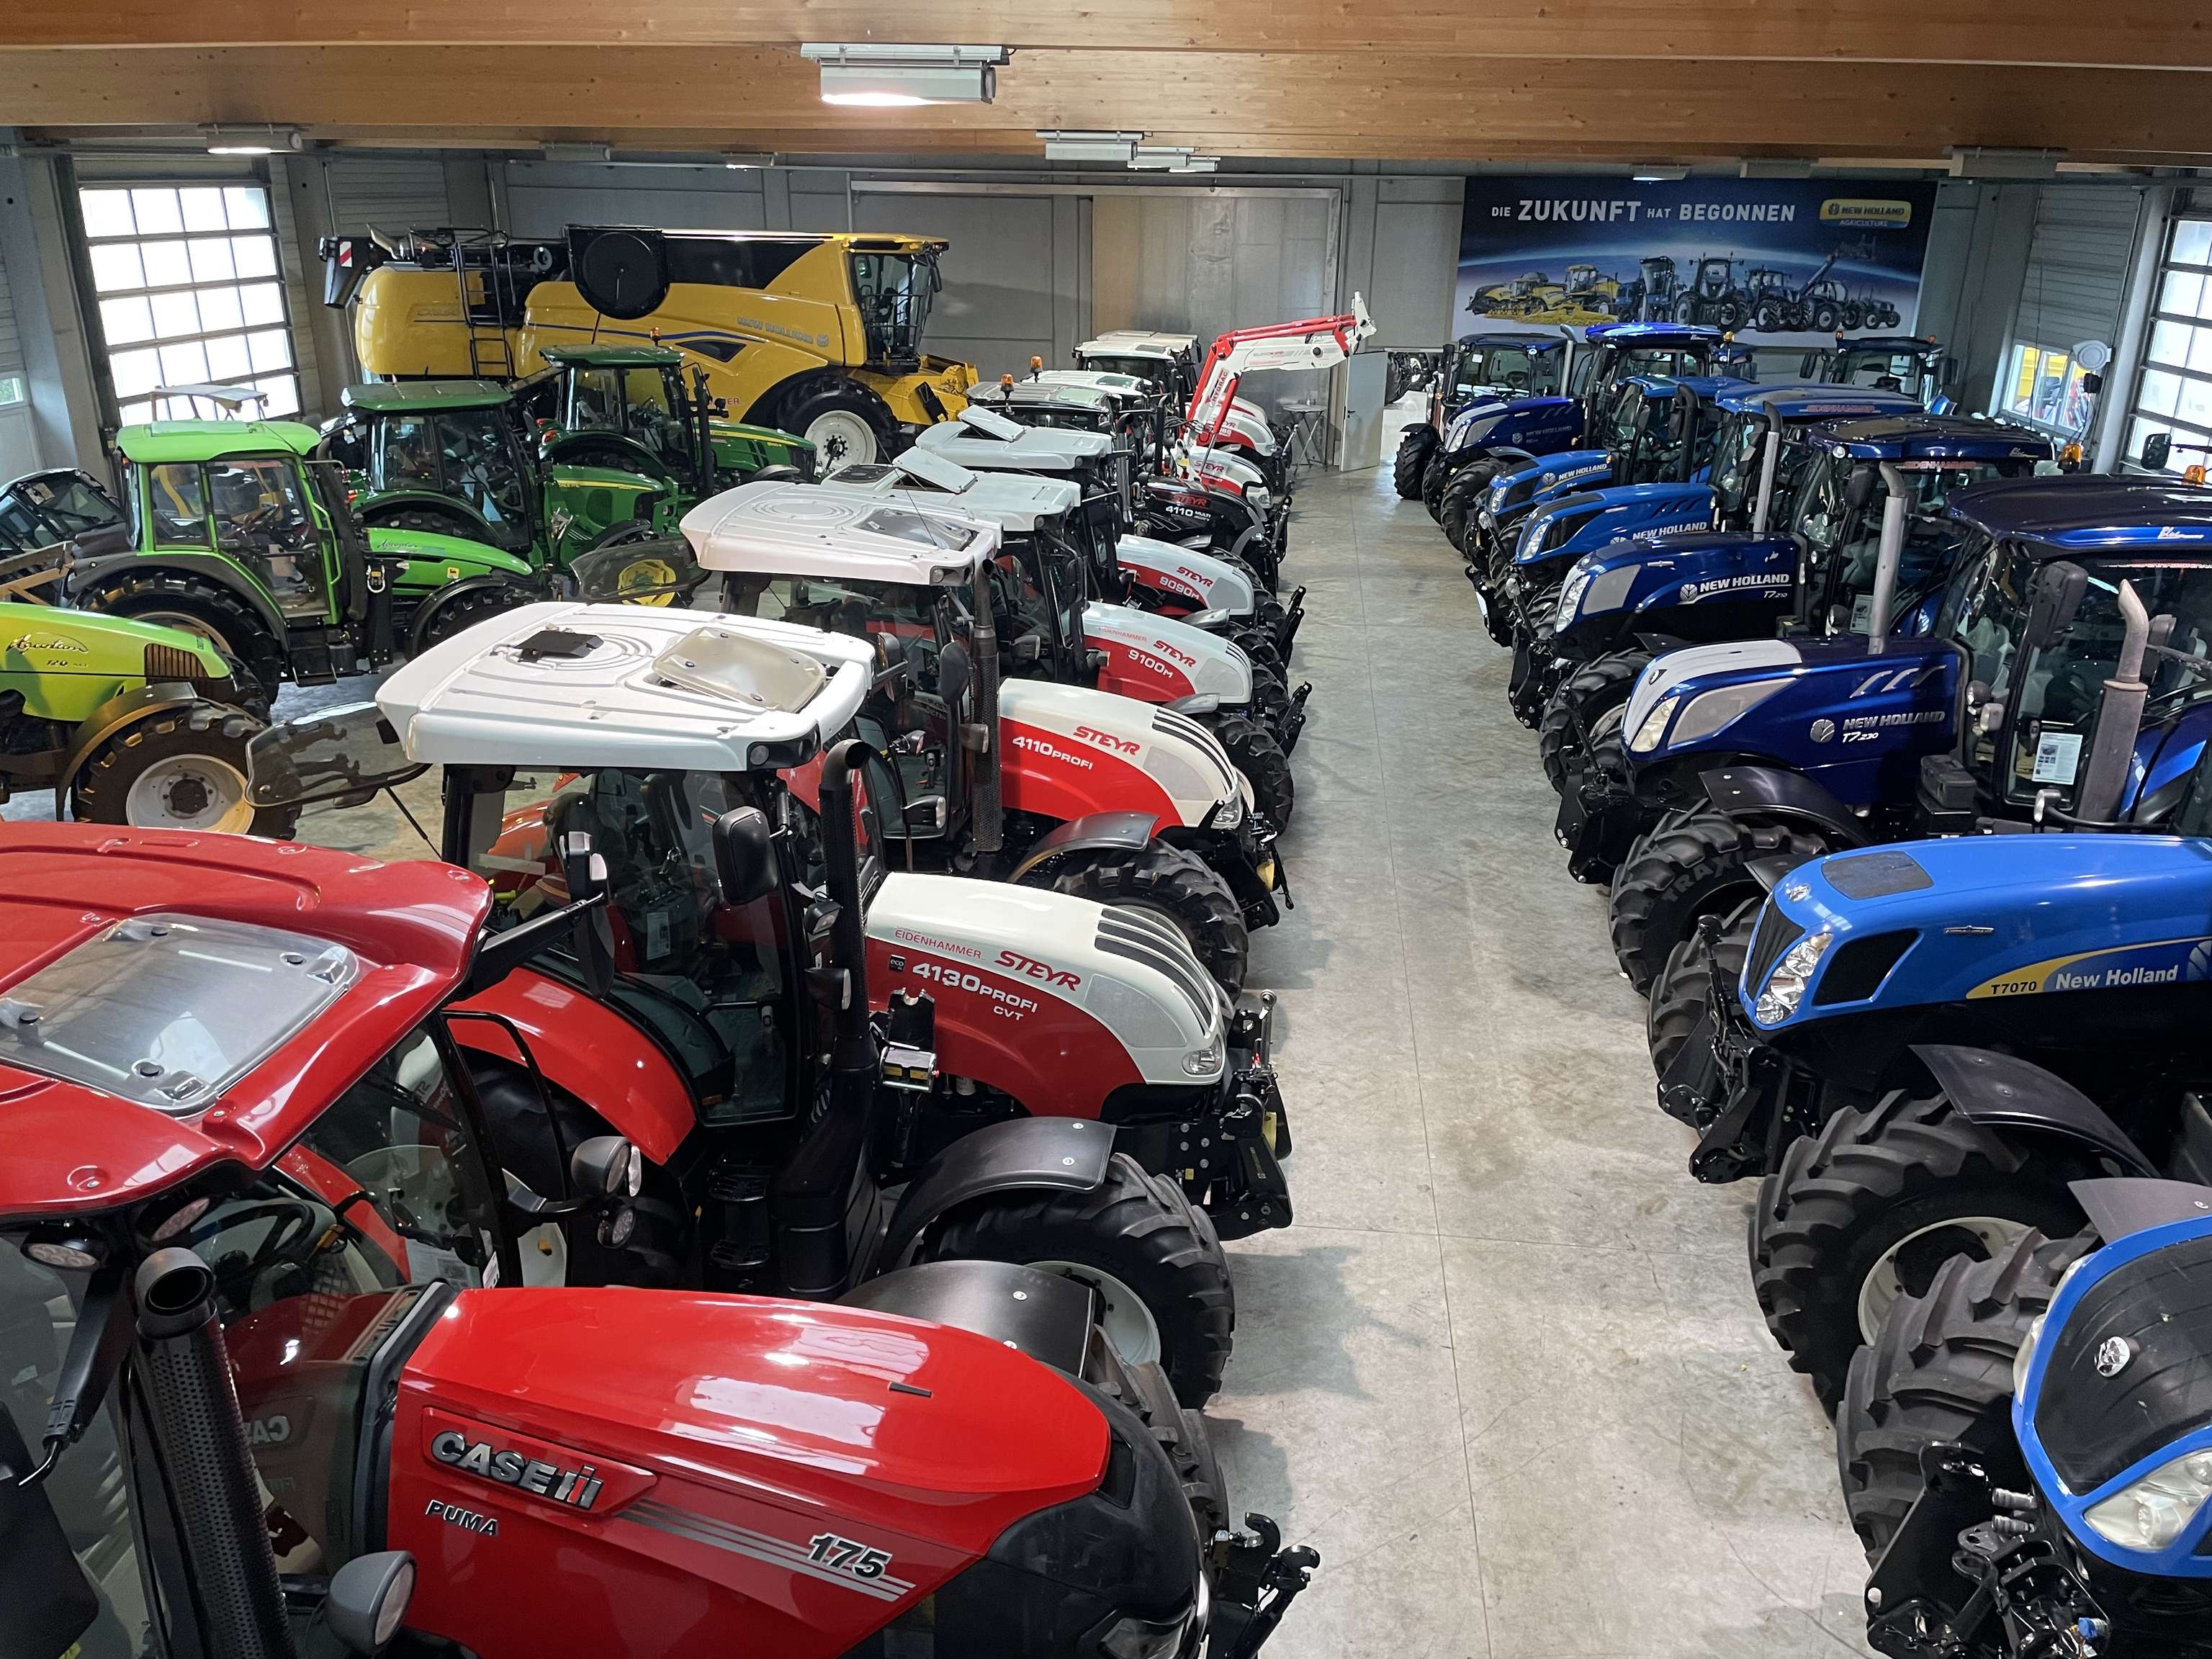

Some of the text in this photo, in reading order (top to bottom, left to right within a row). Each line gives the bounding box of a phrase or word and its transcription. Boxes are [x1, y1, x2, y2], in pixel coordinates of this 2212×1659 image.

[1491, 199, 1796, 222] DIE ZUKUNFT HAT BEGONNEN
[1840, 206, 1905, 216] NEW HOLLAND
[1194, 461, 1224, 473] STEYR
[1558, 463, 1608, 481] NEW HOLLAND
[1173, 493, 1208, 506] STEYR
[1165, 505, 1194, 517] 4110
[1632, 521, 1707, 541] NEW HOLLAND
[1177, 566, 1214, 588] STEYR
[1699, 573, 1790, 593] NEW HOLLAND
[1153, 639, 1197, 667] STEYR
[1128, 649, 1174, 679] 9100M
[1843, 711, 1946, 731] NEW HOLLAND
[1073, 725, 1141, 755] STEYR
[894, 929, 982, 960] EIDENHAMMER
[890, 958, 905, 967] eco
[994, 949, 1082, 992] STEYR
[1990, 980, 2038, 995] T7070
[2054, 963, 2179, 991] New Holland
[993, 1005, 1025, 1022] CVT
[431, 1429, 559, 1496] CASE
[424, 1498, 500, 1537] PUMA
[806, 1532, 894, 1581] 175
